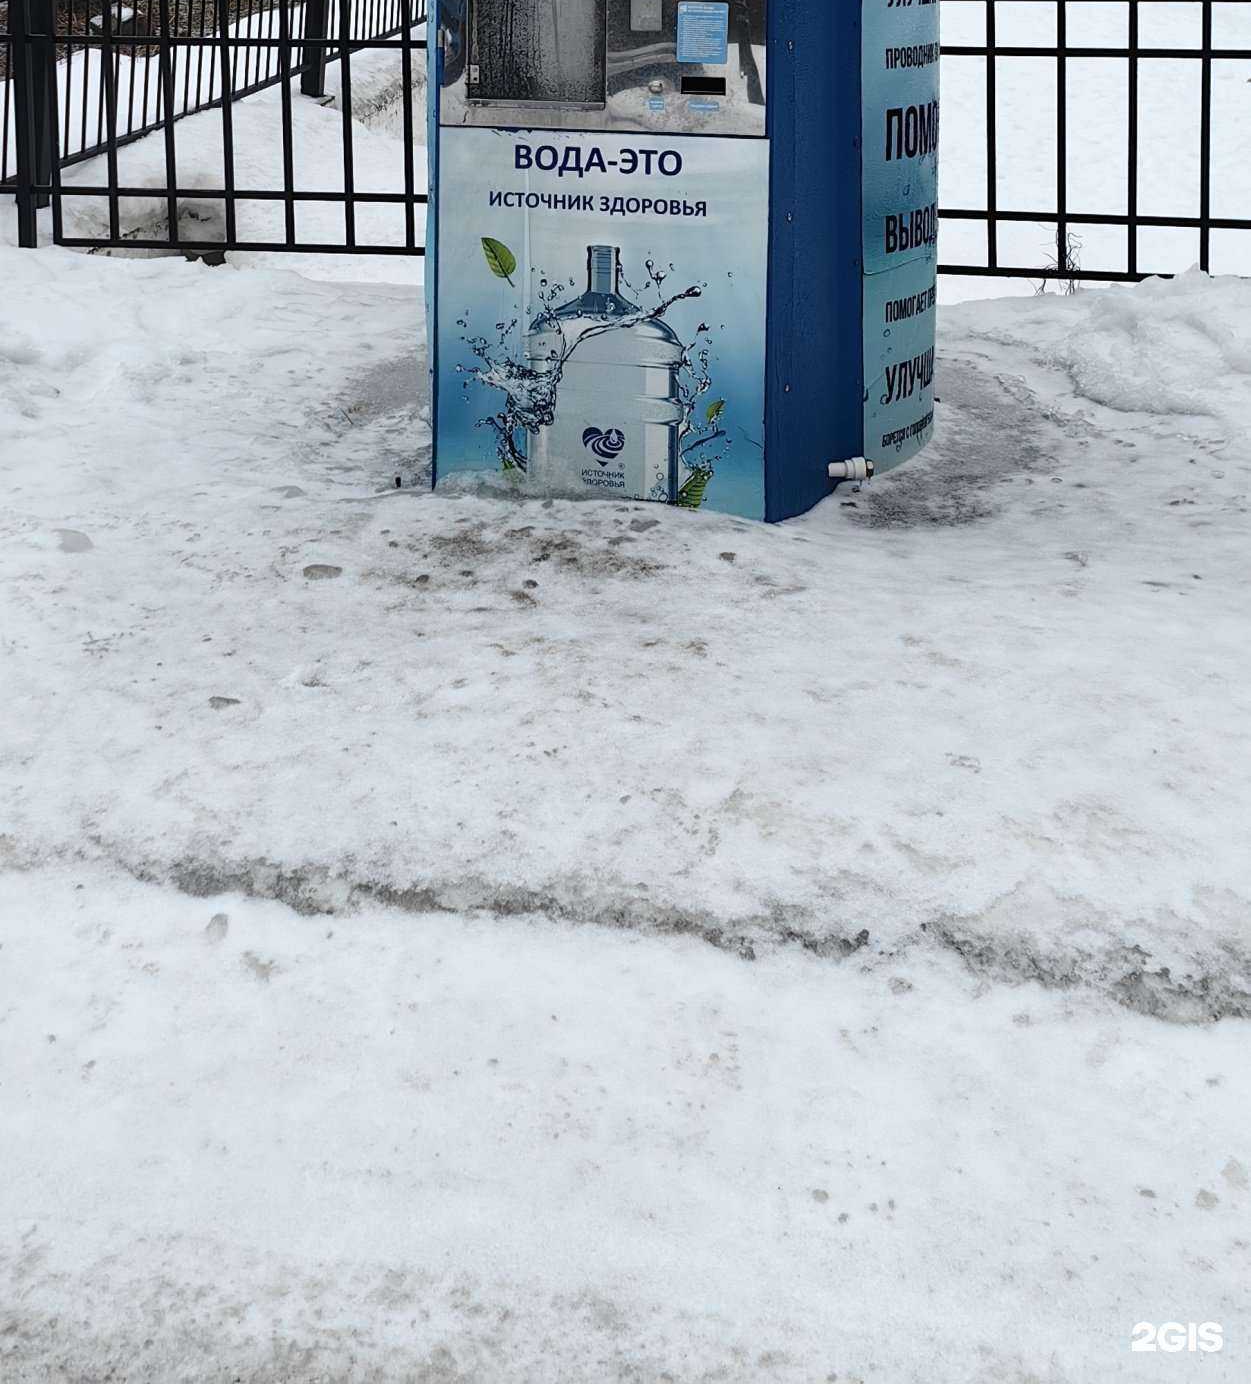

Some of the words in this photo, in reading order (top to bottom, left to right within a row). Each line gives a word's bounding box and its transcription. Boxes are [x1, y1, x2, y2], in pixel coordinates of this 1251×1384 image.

[514, 144, 683, 178] ВОДА-ЭТО
[489, 190, 594, 211] ИСТОЧНИК
[599, 196, 707, 217] ЗДОРОВЬЯ
[885, 290, 927, 323] ПОМОГАЕТ
[581, 468, 625, 479] ИСТОЧНИК
